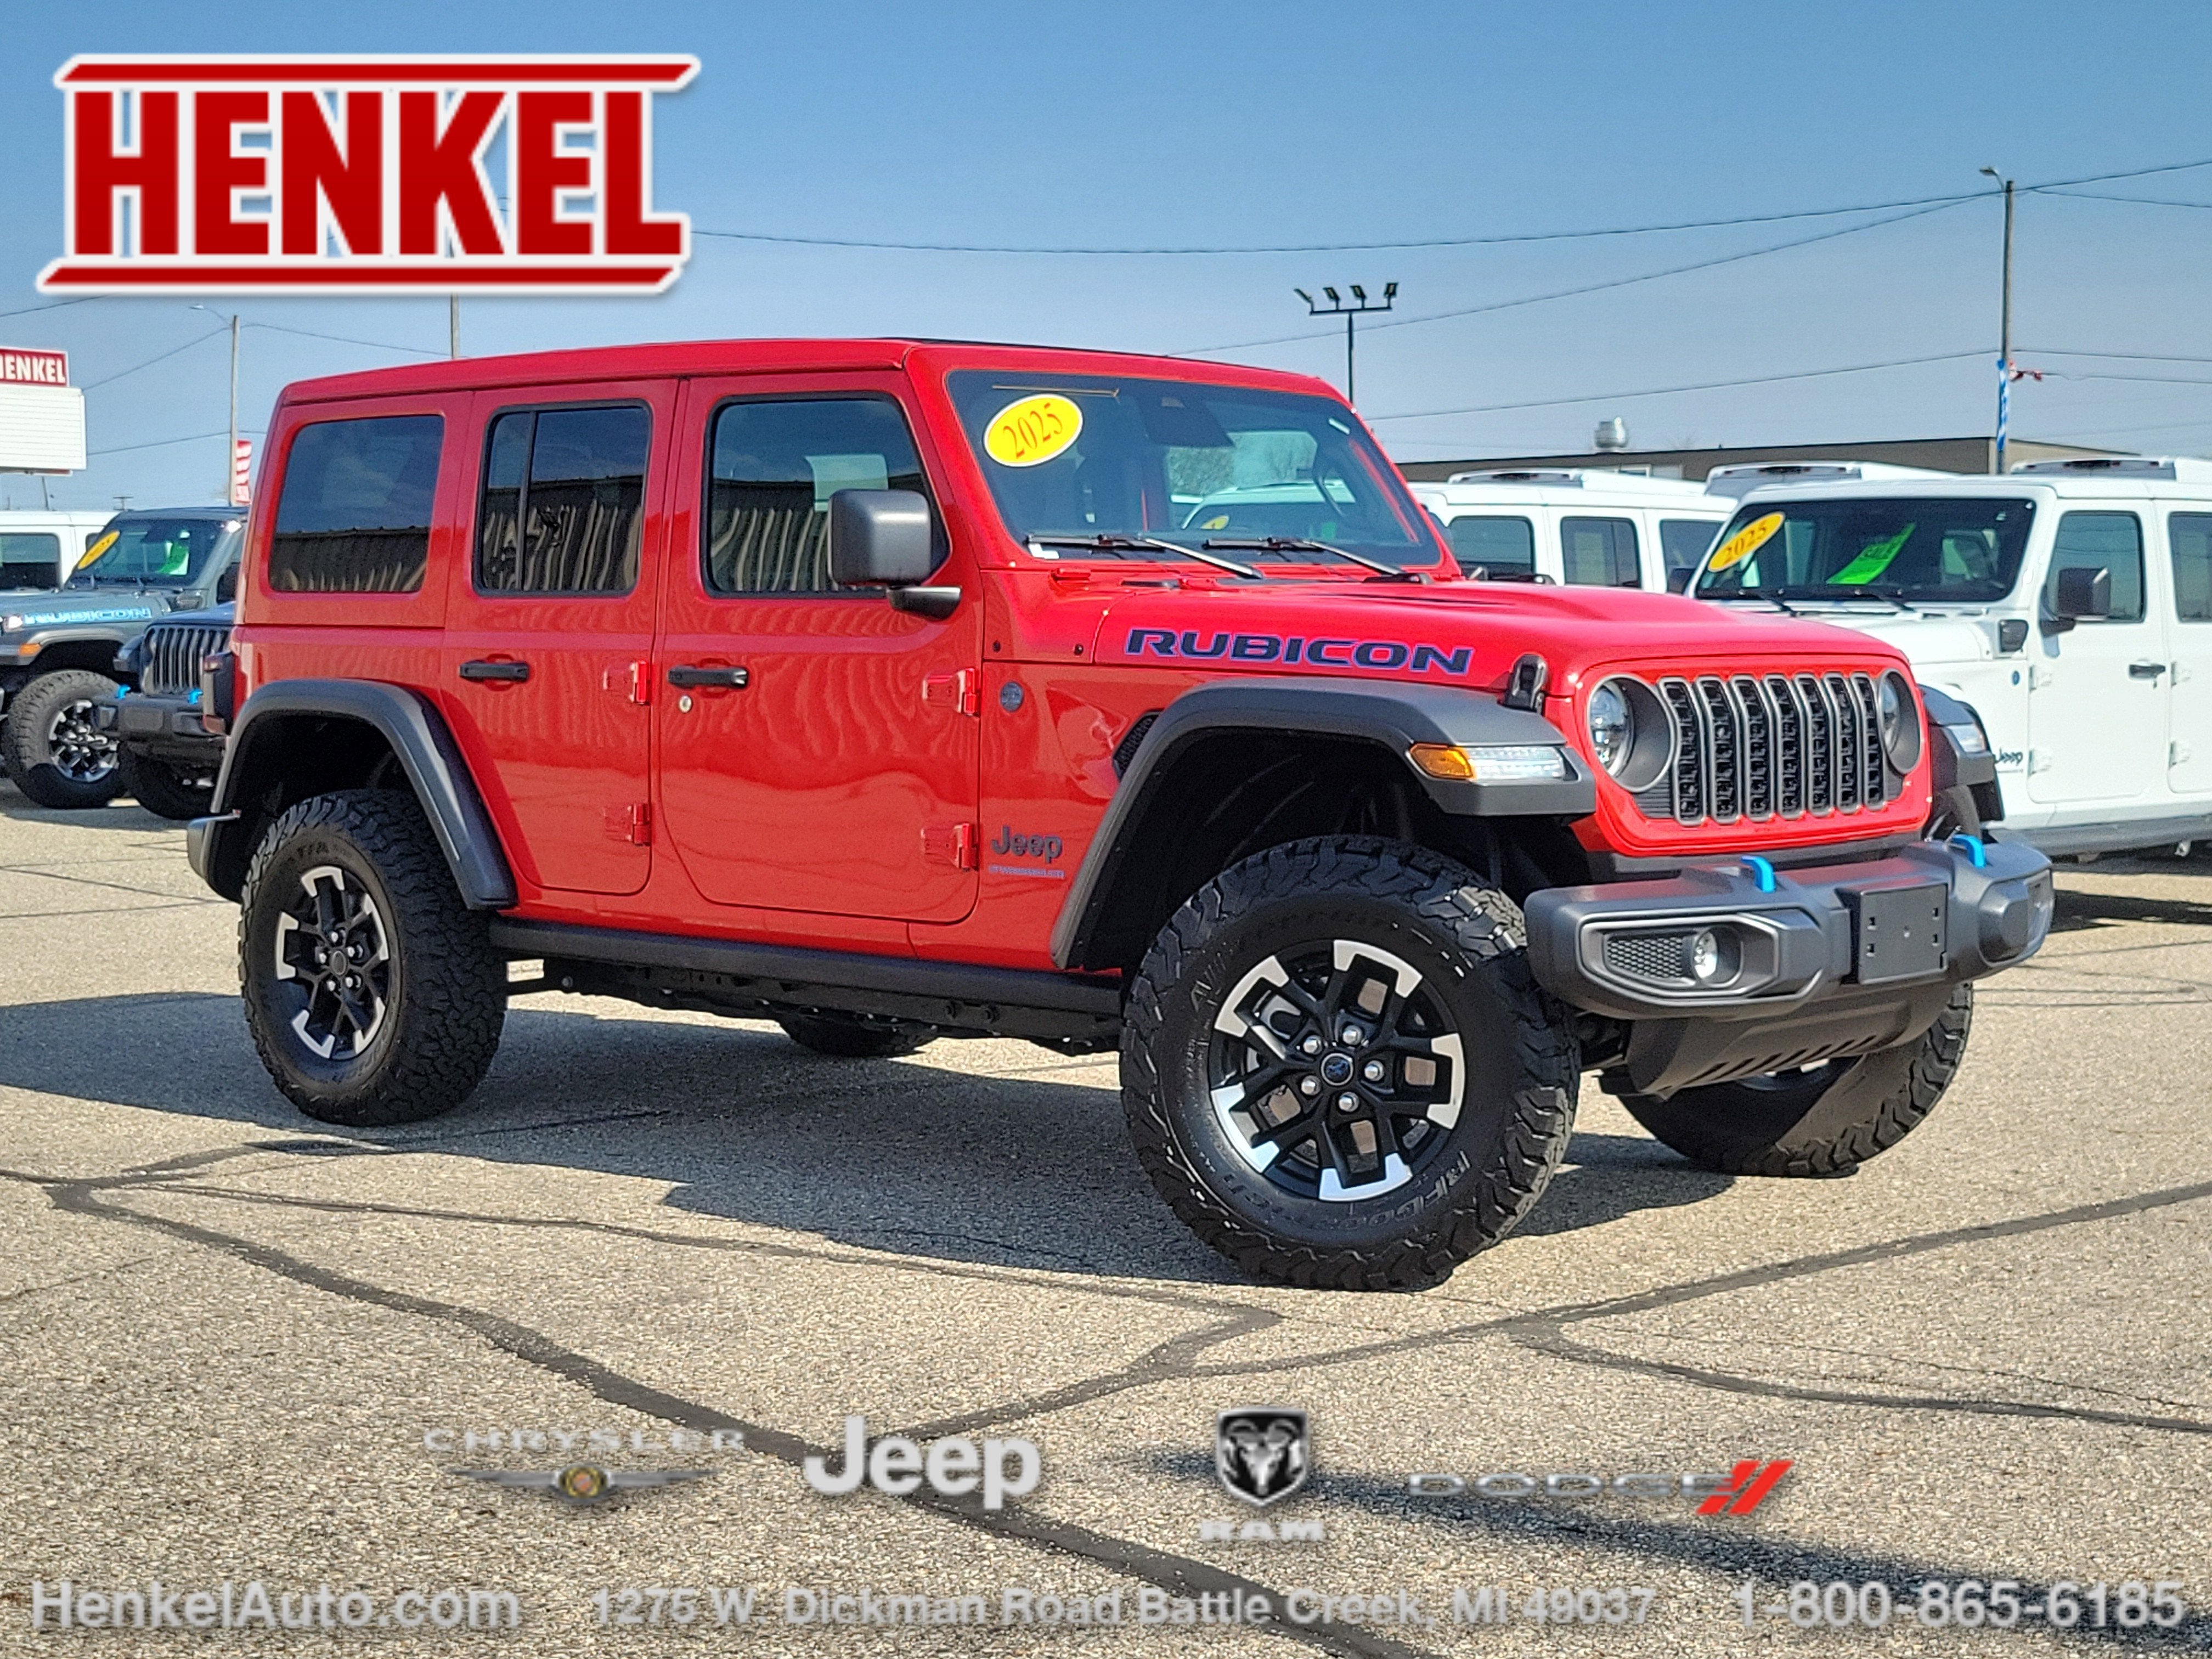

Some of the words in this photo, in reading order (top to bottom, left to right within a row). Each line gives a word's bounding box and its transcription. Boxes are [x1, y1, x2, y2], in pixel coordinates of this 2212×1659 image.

[1003, 402, 1063, 459] 2025
[1724, 520, 1767, 565] 2025
[24, 607, 152, 625] RUBICON
[1125, 629, 1474, 675] RUBICON
[1994, 748, 2023, 766] Jeep
[991, 825, 1062, 864] Jeep
